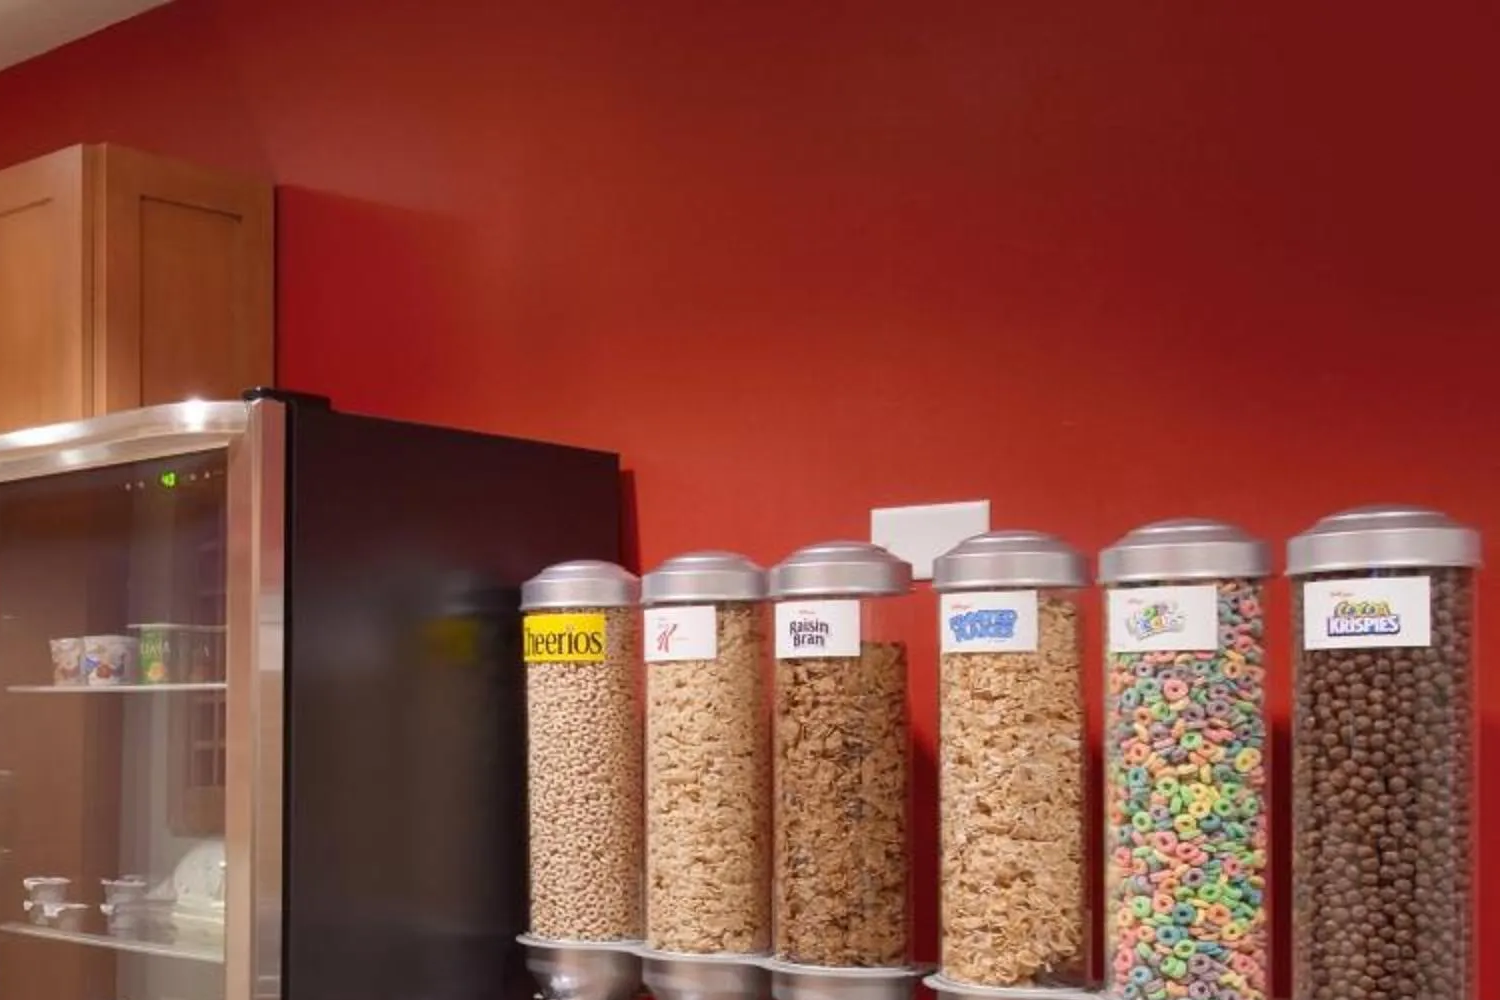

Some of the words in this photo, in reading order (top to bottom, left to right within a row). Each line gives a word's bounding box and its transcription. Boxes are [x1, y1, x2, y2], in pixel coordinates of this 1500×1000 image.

[789, 618, 829, 636] Raisin
[1328, 615, 1400, 637] KRISPIES
[523, 625, 603, 657] heerios
[793, 633, 825, 648] Bran
